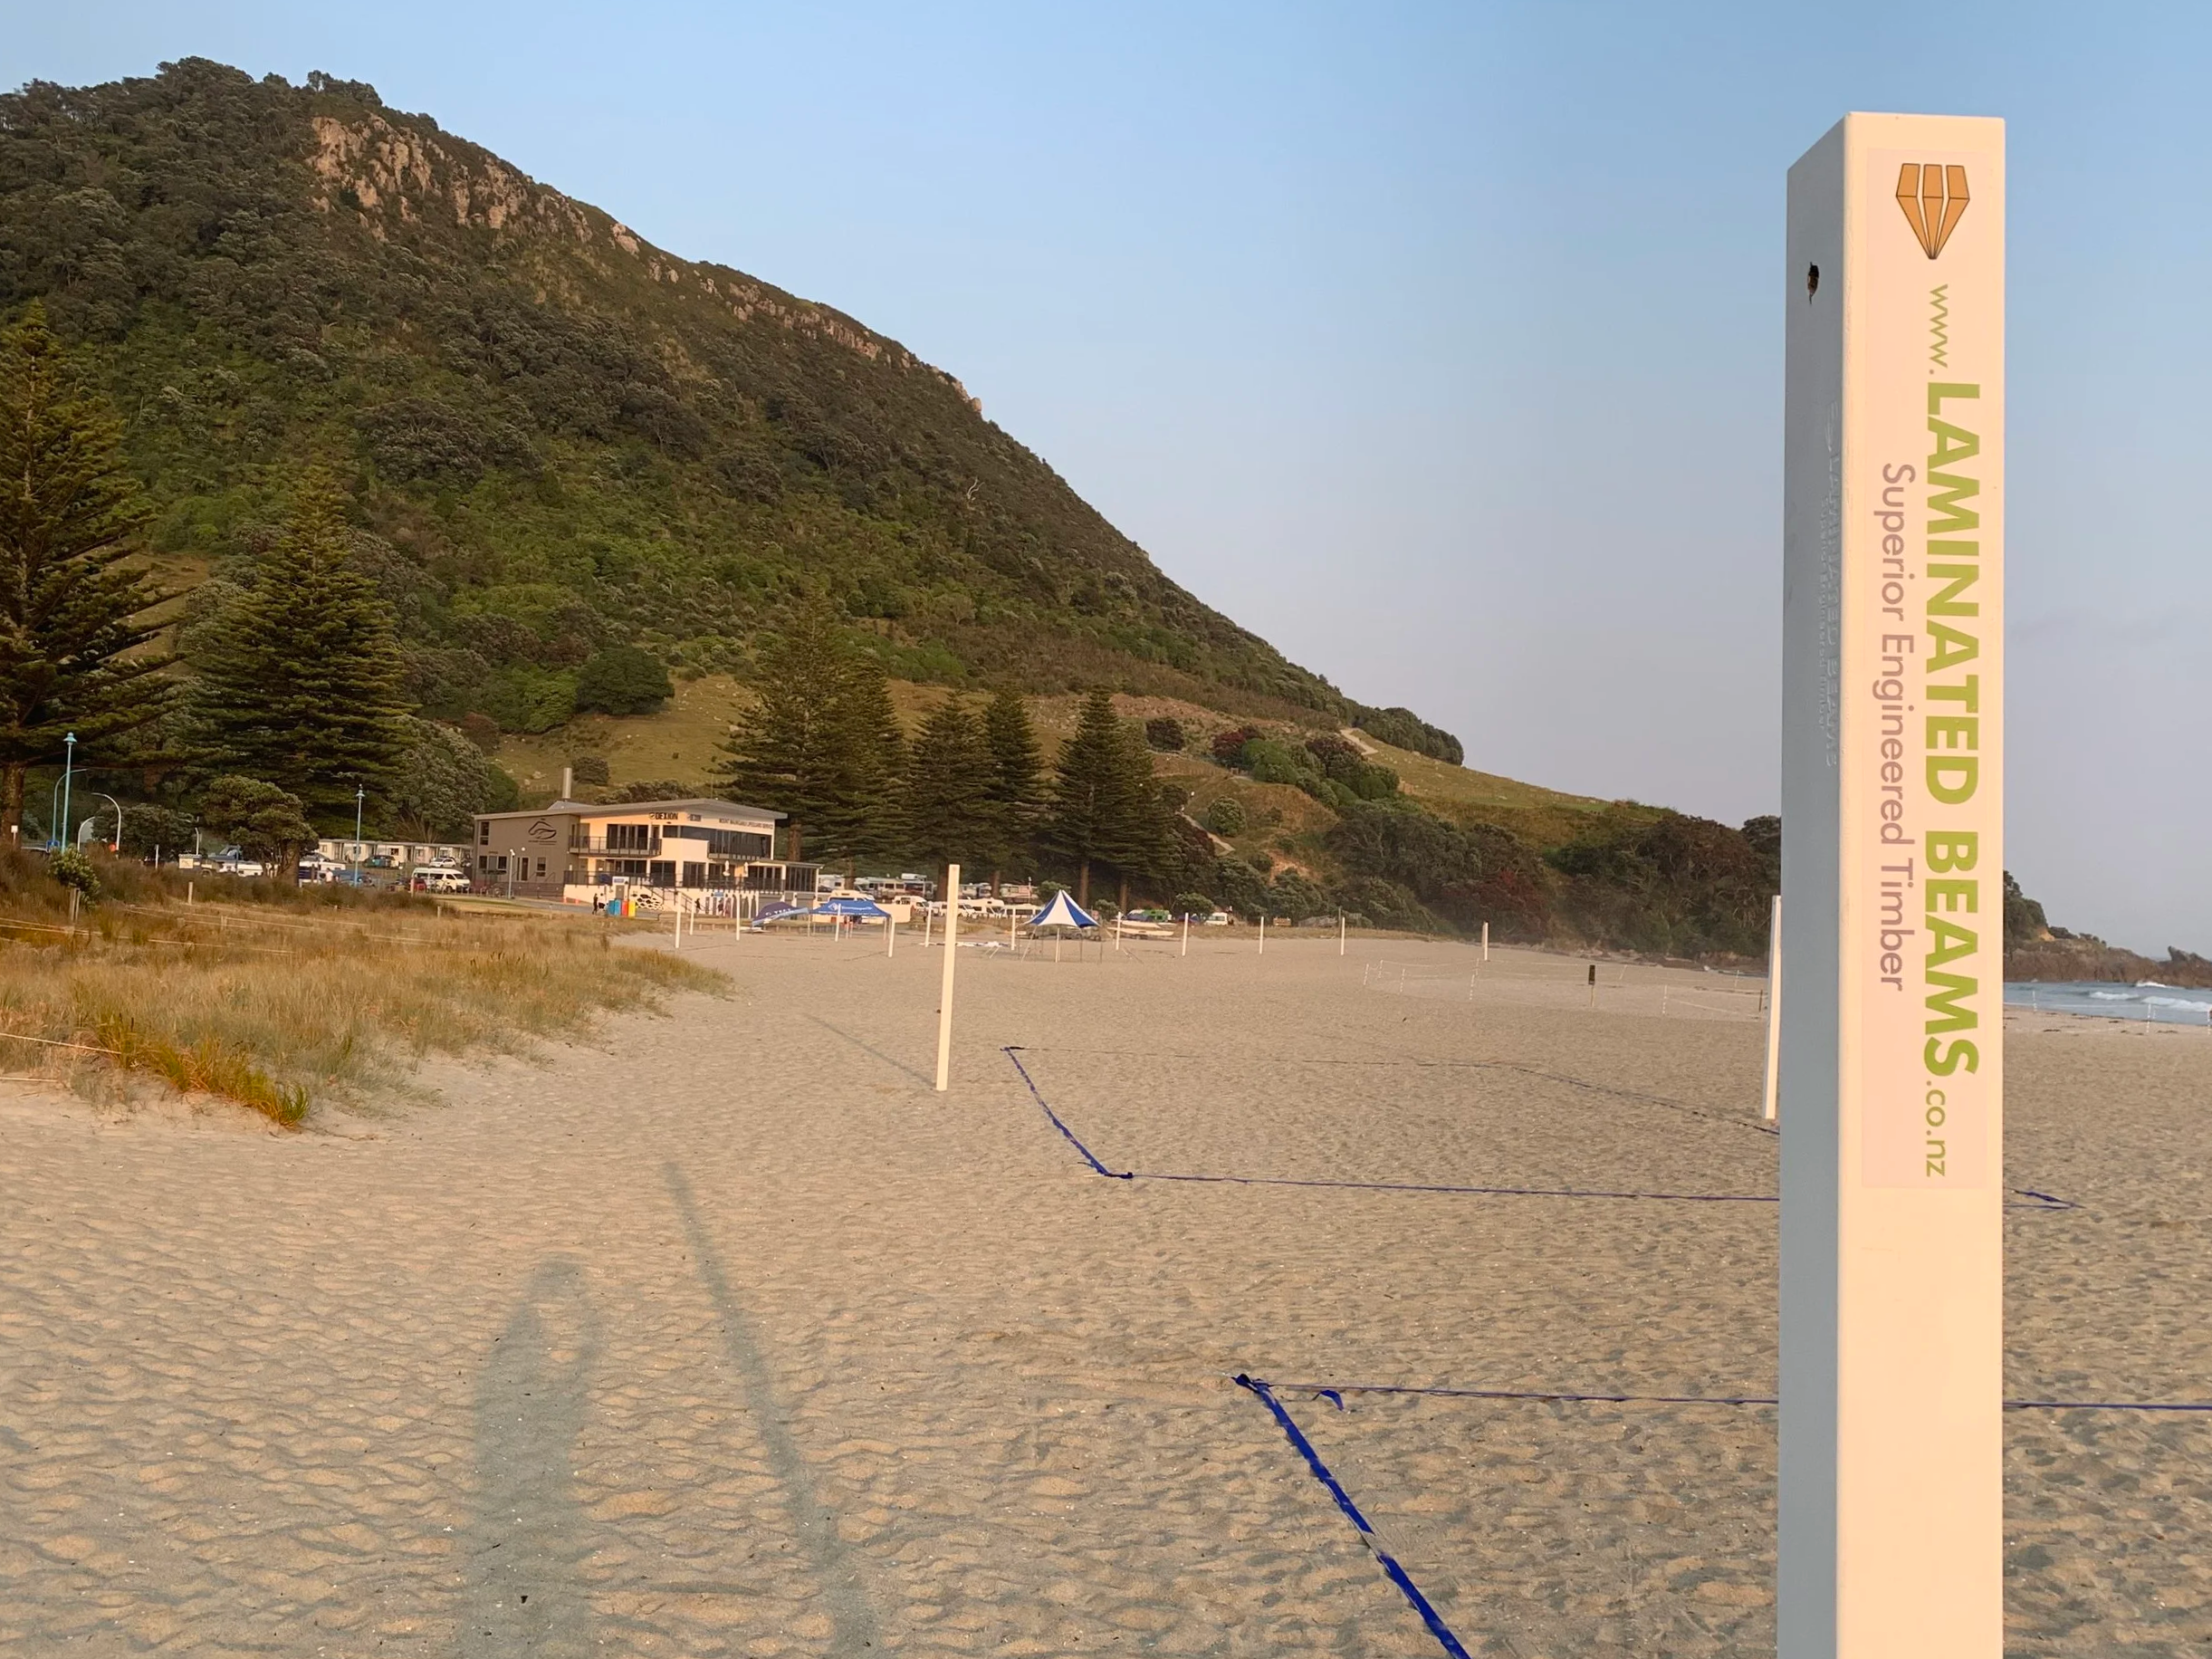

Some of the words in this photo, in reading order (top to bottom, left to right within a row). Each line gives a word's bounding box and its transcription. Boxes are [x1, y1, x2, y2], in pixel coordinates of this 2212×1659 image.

[1872, 463, 1915, 622] Superior
[1872, 634, 1915, 845] Engineered
[1880, 858, 1915, 993] Timber
